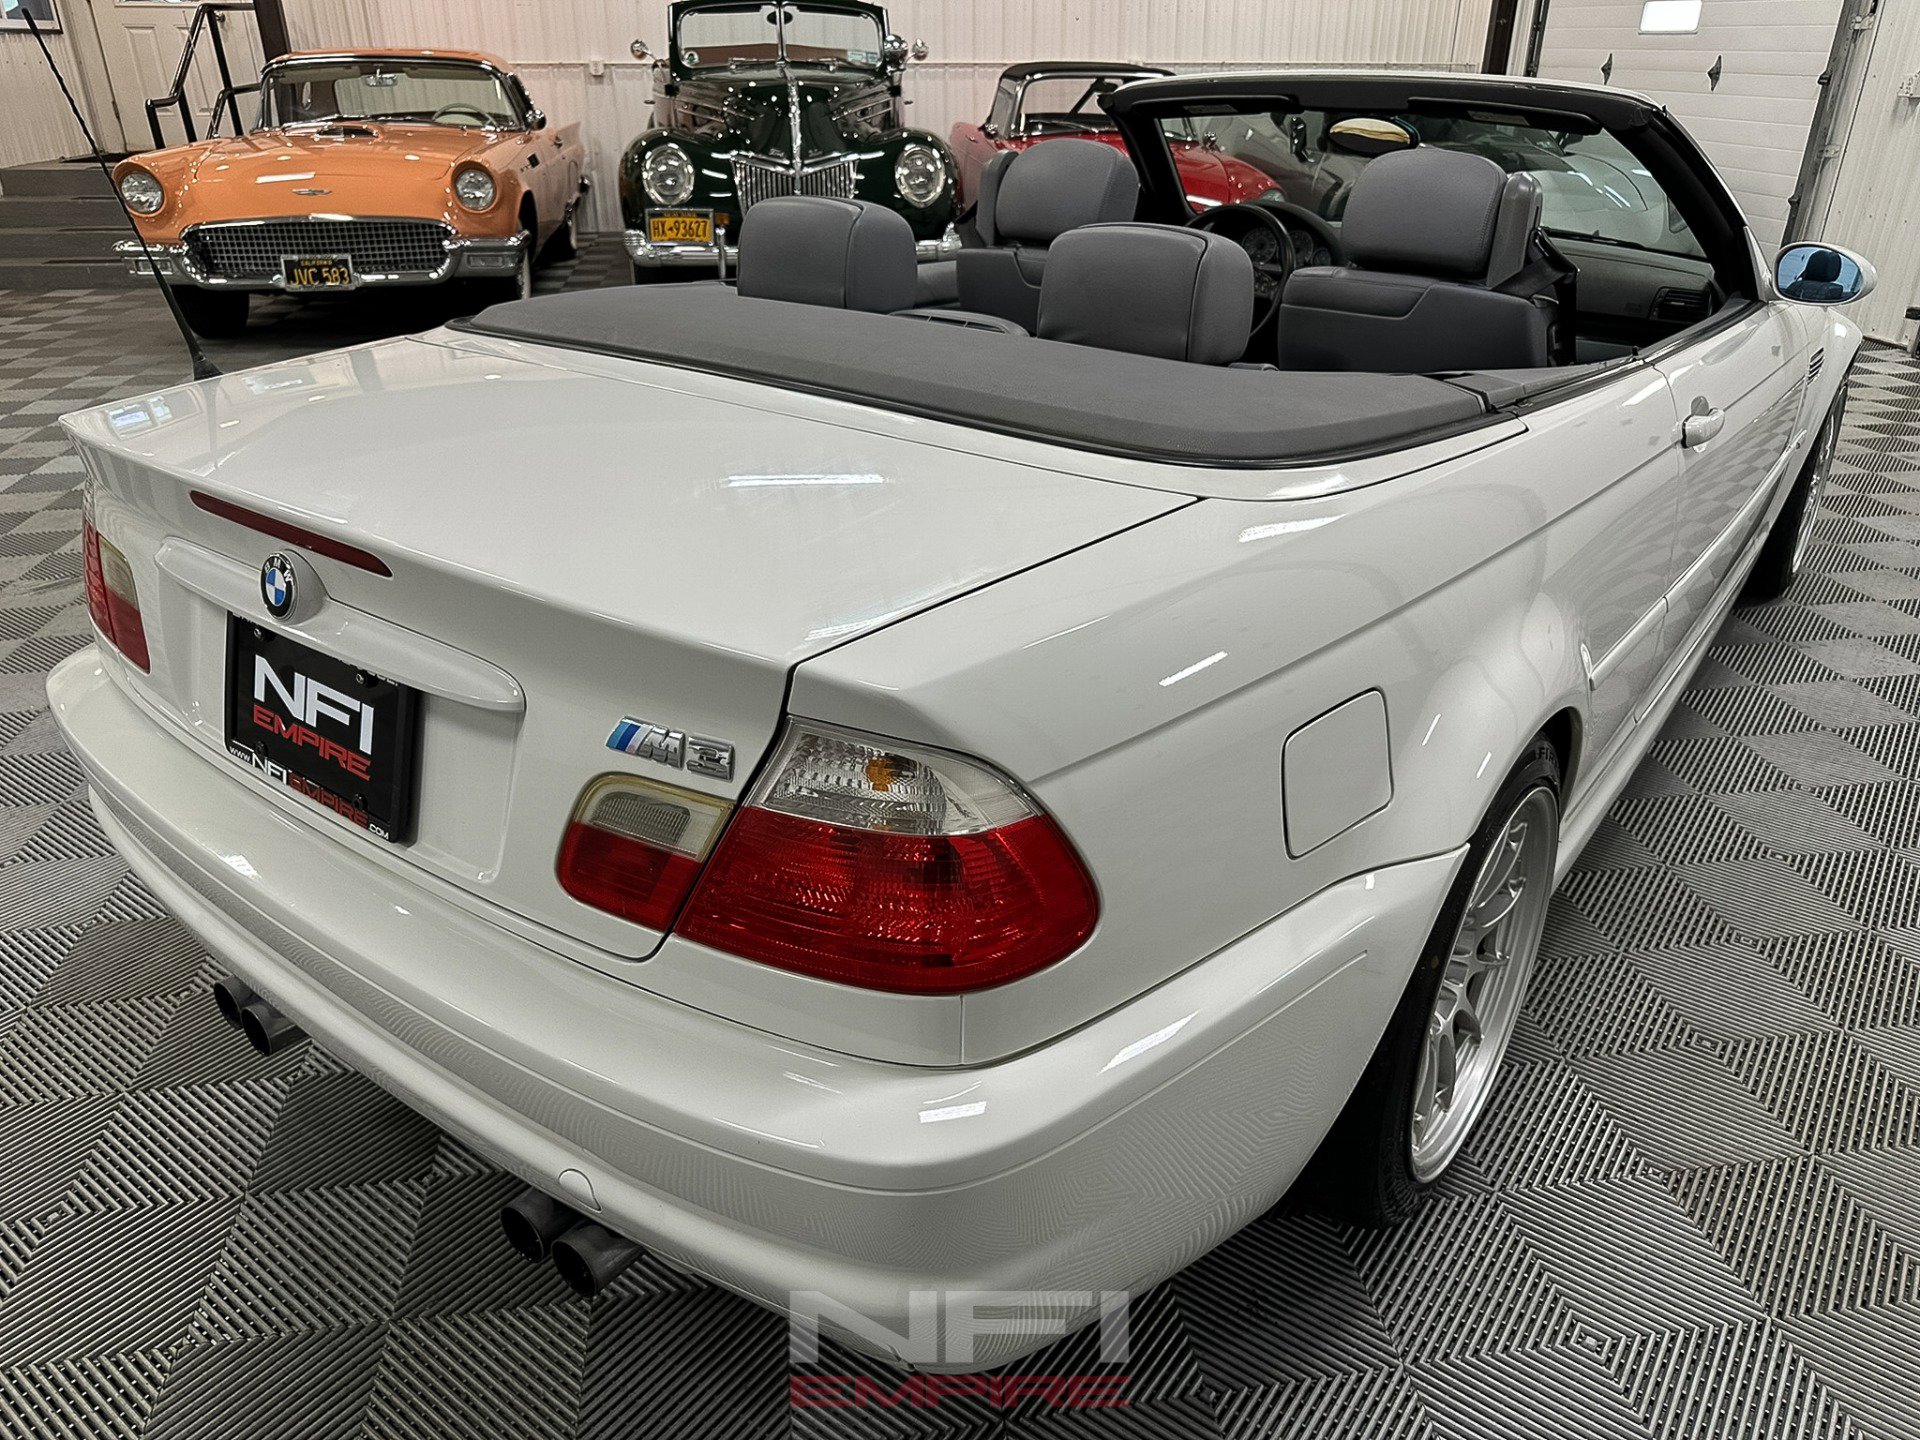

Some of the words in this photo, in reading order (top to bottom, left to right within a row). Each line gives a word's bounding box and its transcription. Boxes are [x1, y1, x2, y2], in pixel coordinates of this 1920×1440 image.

[290, 268, 320, 286] JVC
[321, 267, 350, 286] 583
[264, 557, 294, 586] BMW
[253, 653, 375, 756] NFI
[253, 704, 372, 781] EMPIRE
[630, 722, 736, 783] M3
